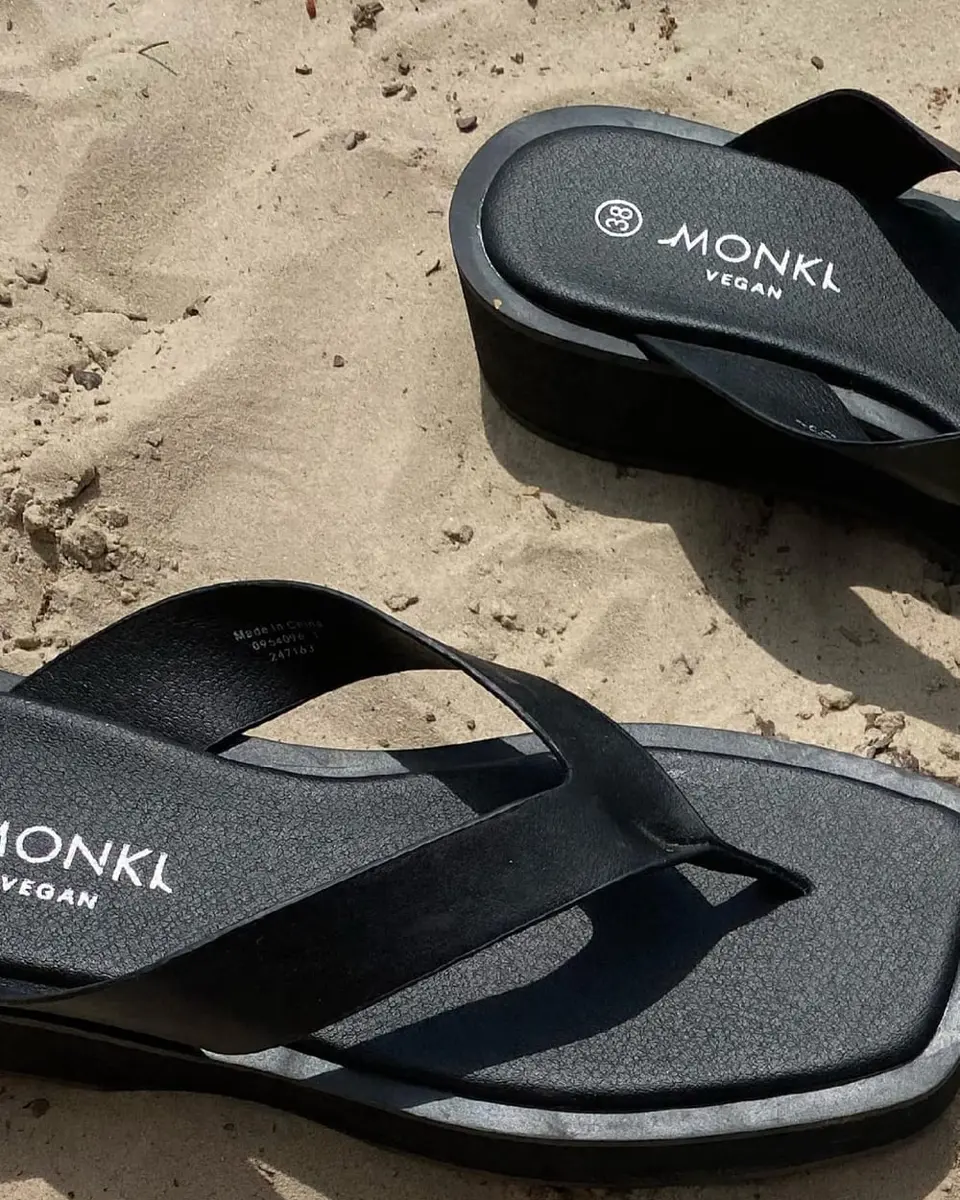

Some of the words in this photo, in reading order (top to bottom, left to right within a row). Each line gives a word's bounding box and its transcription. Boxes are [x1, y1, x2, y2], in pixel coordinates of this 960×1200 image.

[604, 205, 634, 232] 38
[705, 269, 782, 300] VEGAN
[233, 626, 268, 642] Made
[1, 874, 99, 910] VEGAN
